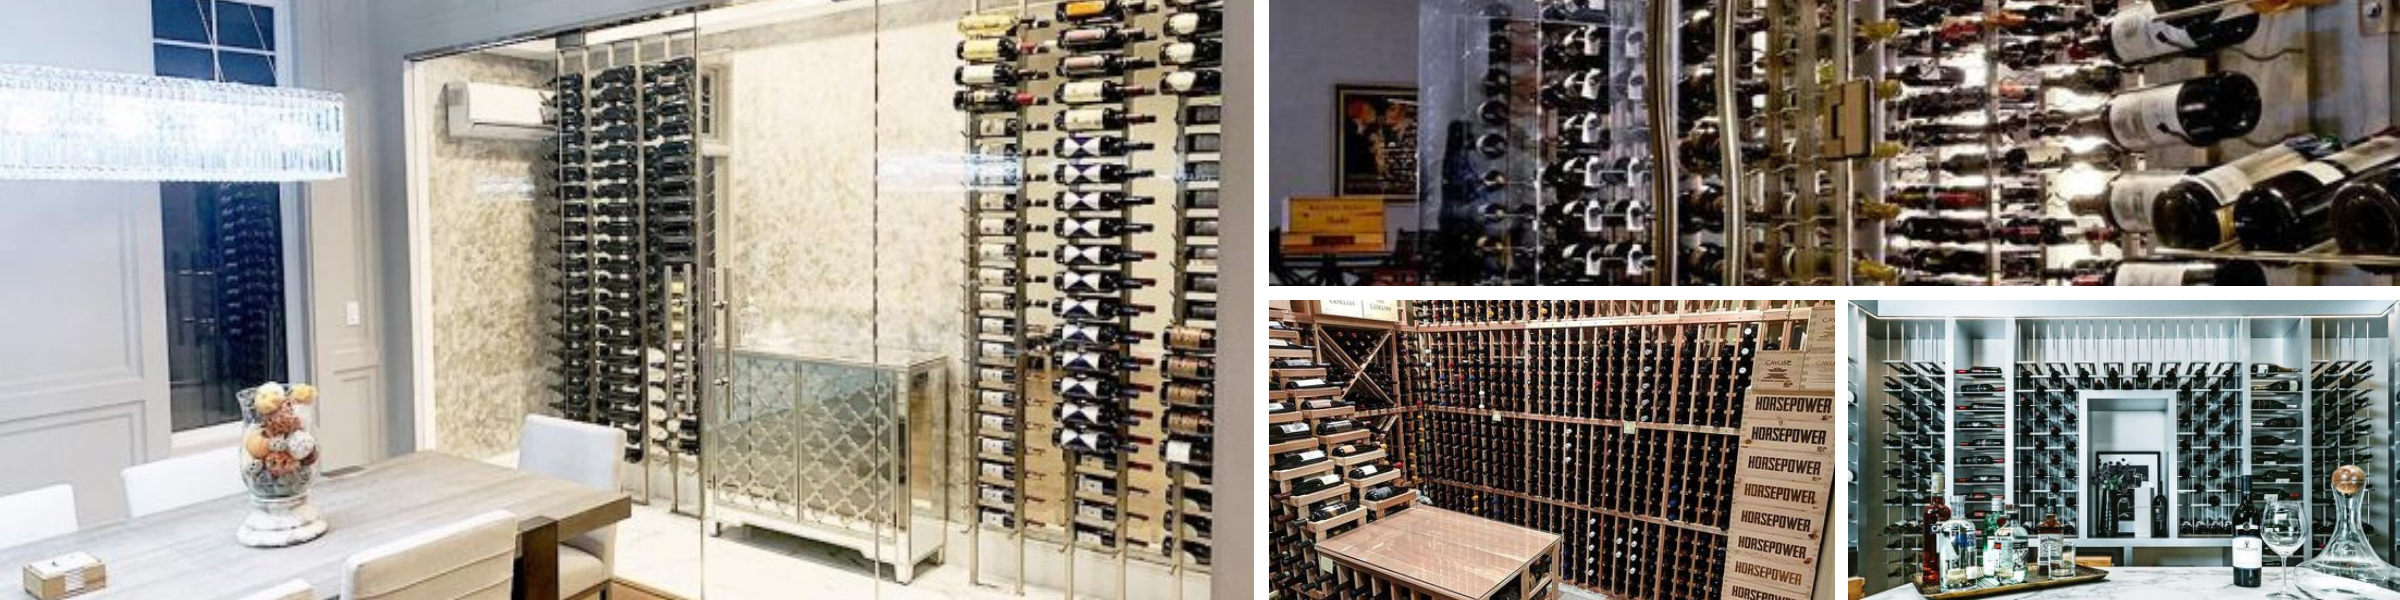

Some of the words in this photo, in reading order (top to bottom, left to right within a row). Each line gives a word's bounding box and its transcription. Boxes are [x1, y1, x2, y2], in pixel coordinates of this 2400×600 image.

[1755, 396, 1833, 414] HORSEPOWER
[1751, 426, 1827, 445] HORSEPOWER
[1748, 455, 1822, 476] HORSEPOWER
[1744, 483, 1816, 505] HORSEPOWER
[1741, 510, 1811, 533] HORSEPOWER
[1738, 535, 1807, 559] HORSEPOWER
[1734, 560, 1803, 586] HORSEPOWER
